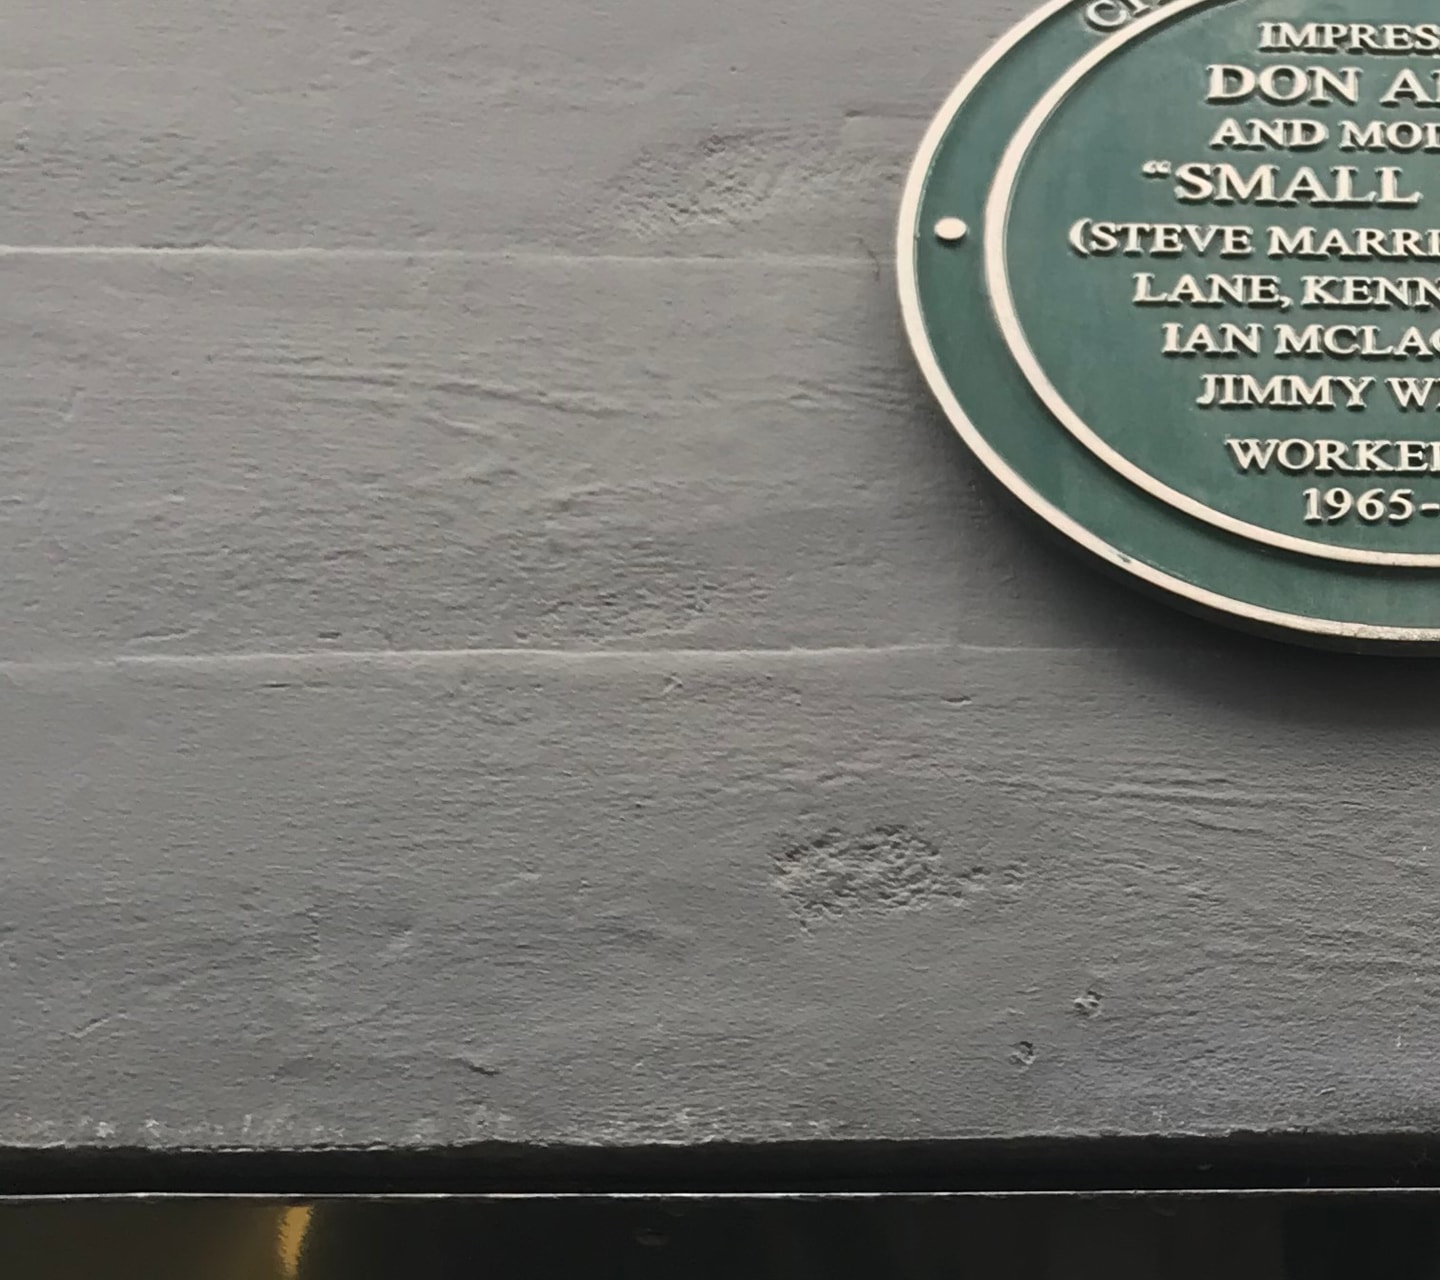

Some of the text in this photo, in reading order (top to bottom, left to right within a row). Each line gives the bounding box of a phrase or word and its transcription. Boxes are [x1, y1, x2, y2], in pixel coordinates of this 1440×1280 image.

[1206, 64, 1363, 105] DON
[1209, 119, 1328, 151] AND
[1142, 161, 1423, 206] “SMALL
[1068, 218, 1255, 257] (STEVE
[1132, 273, 1293, 312] LANE,
[1161, 322, 1262, 357] IAN
[1195, 373, 1376, 409] JIMMY
